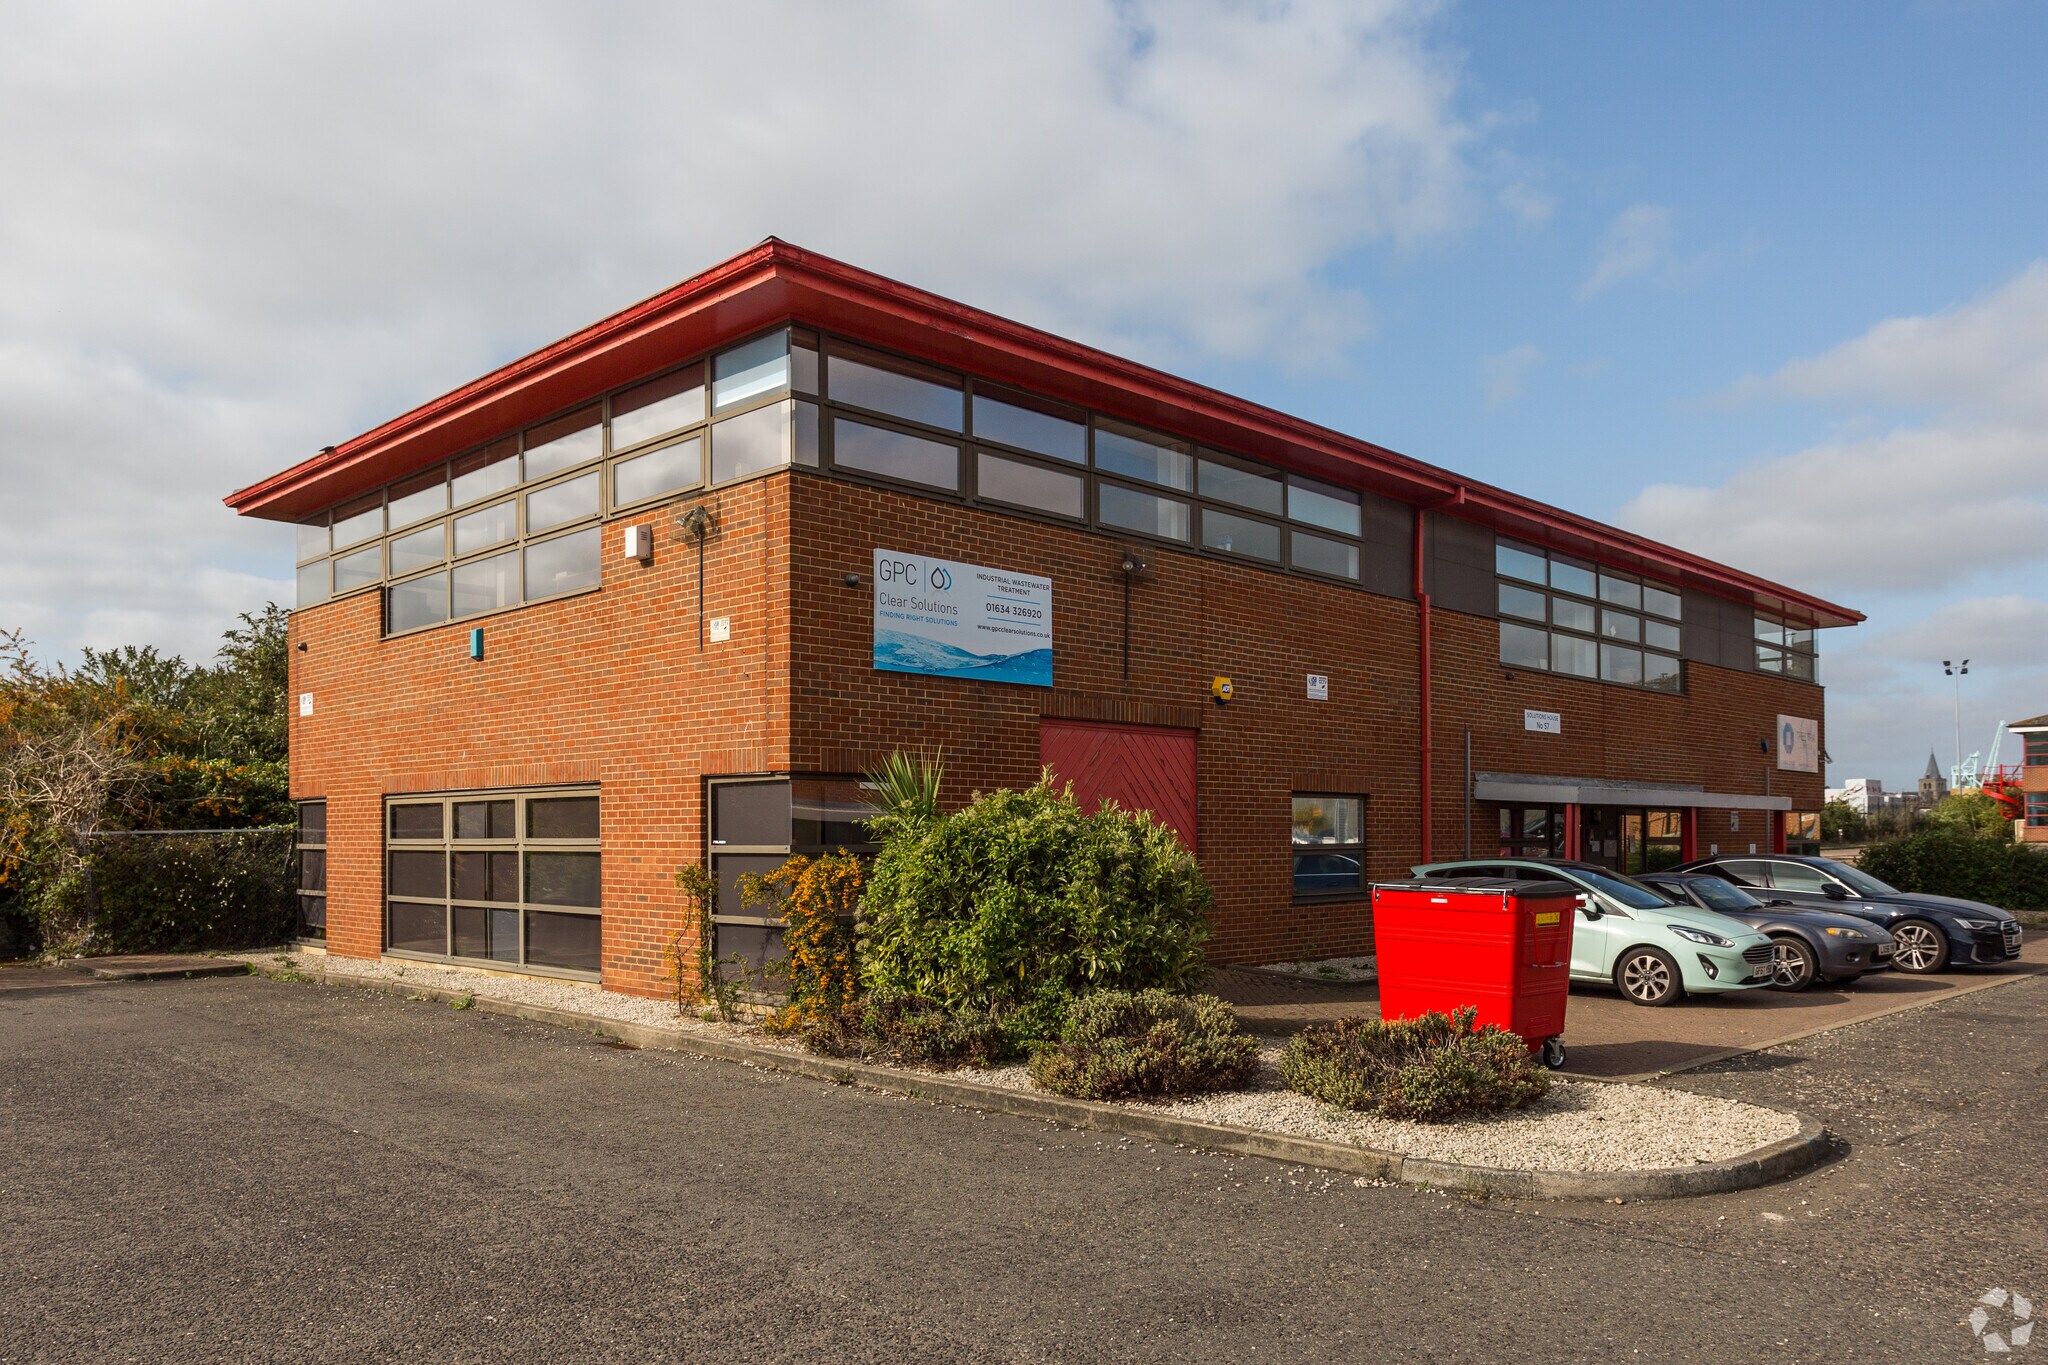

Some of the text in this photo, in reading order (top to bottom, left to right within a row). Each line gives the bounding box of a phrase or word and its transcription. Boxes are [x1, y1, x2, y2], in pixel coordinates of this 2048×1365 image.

[879, 559, 917, 586] GPC
[976, 573, 1051, 591] INDUSTRIAL WASTEWATER
[997, 585, 1031, 596] TREATMENT
[879, 592, 958, 616] Clear Solutions
[985, 602, 1042, 619] 01634 326920
[879, 610, 958, 627] FINDING RIGHT SOLUTIONS
[977, 624, 1051, 639] www.gpcclearsolutions.co.uk
[1526, 712, 1559, 722] SOLUTIONS HOUSE
[1536, 722, 1543, 730] No
